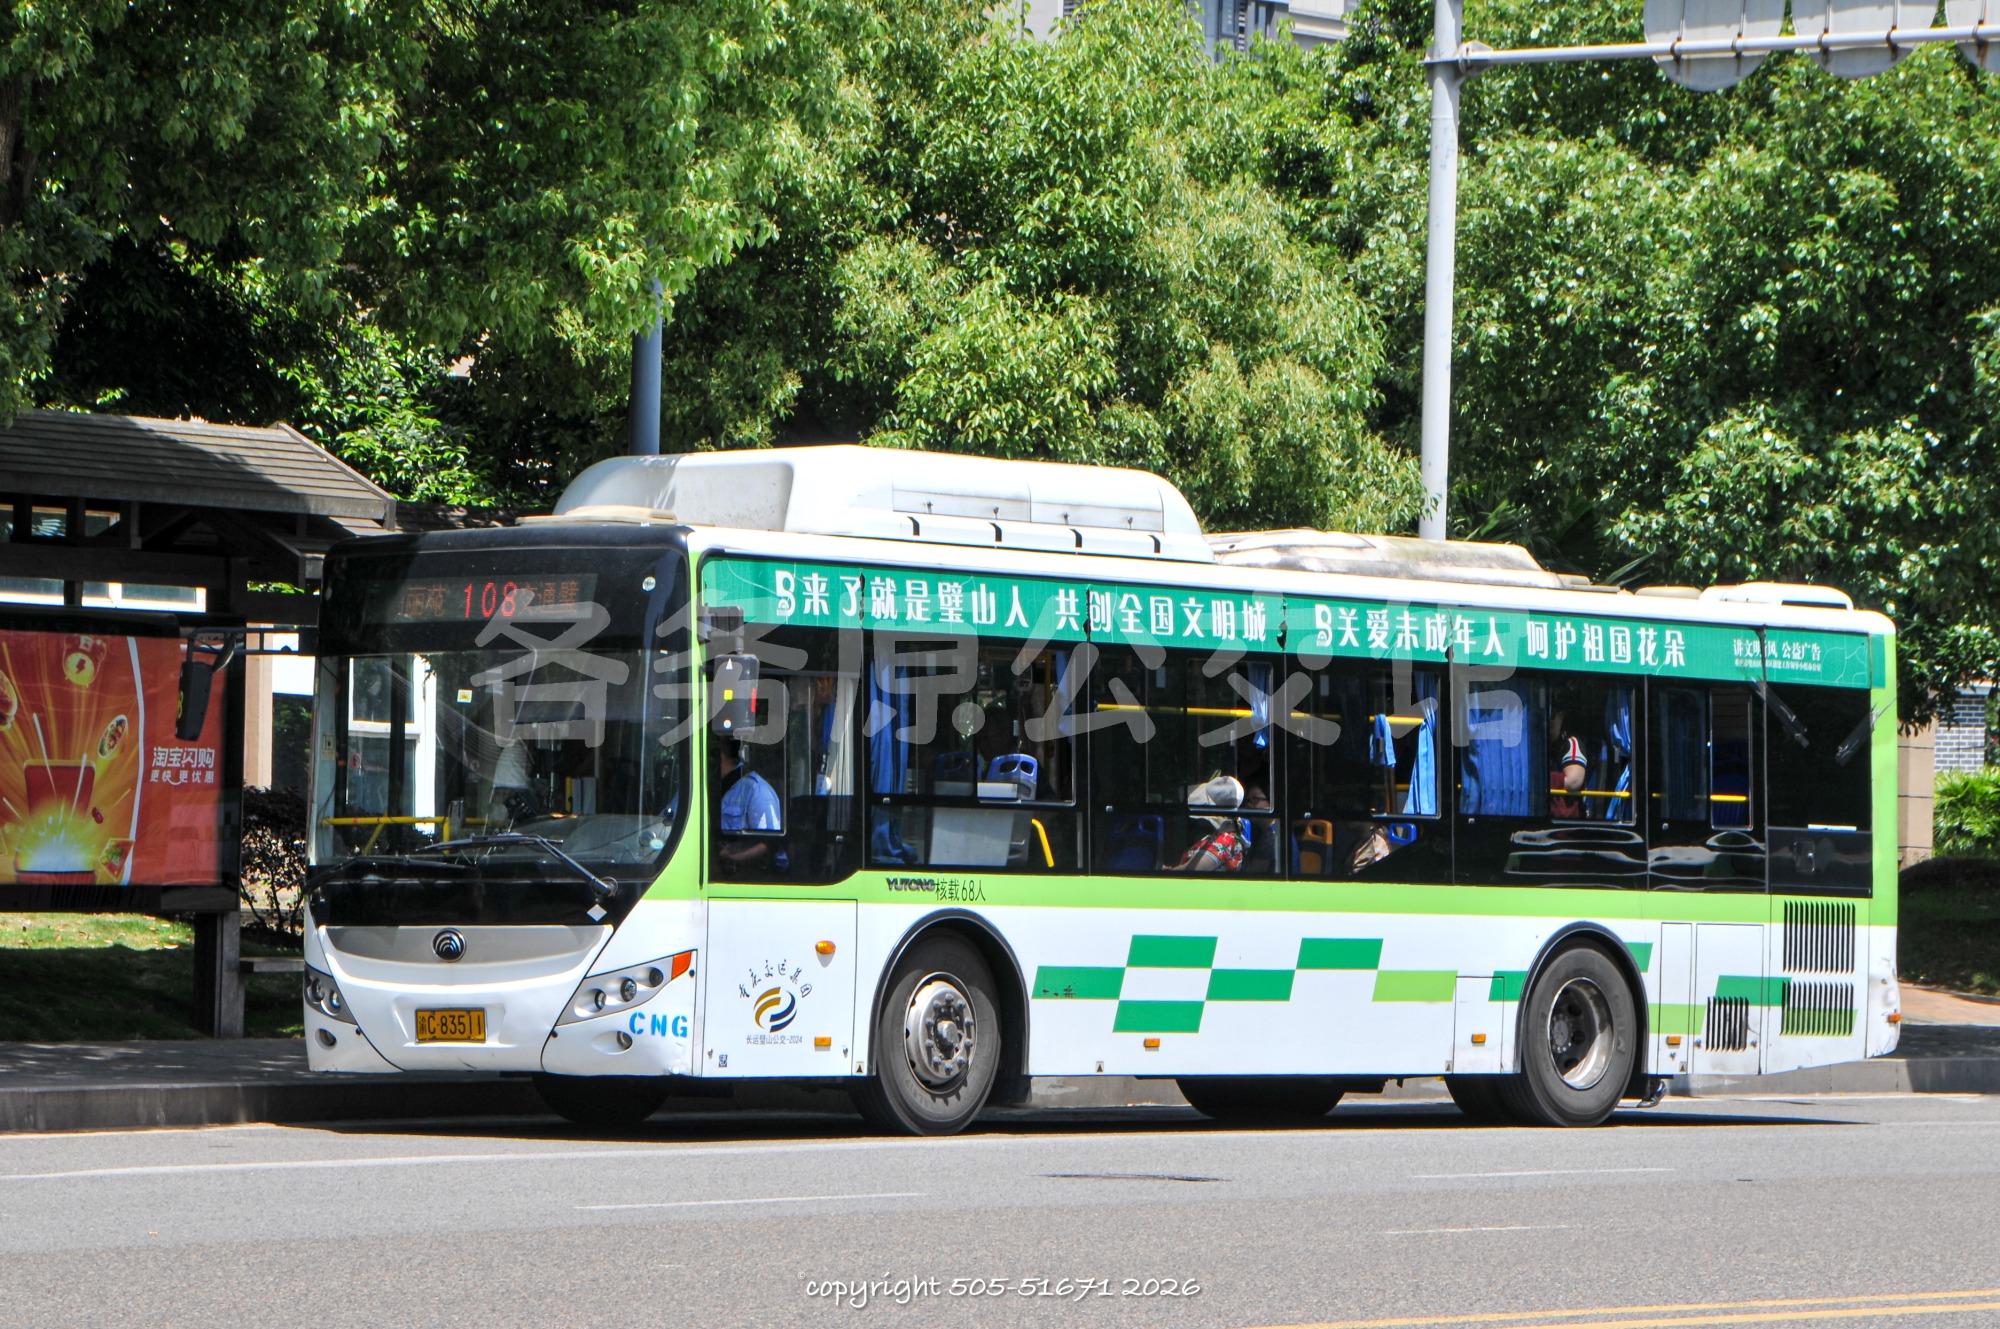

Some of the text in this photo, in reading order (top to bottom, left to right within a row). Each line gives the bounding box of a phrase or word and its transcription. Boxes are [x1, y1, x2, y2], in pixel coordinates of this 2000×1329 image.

[463, 581, 518, 618] 108
[802, 571, 1267, 642] 来了就是璧山人 共创全国文明城
[1338, 606, 1686, 668] 关爱未成年人 呵护祖国花朵
[1782, 640, 1821, 662] 公益广告
[152, 747, 215, 768] 淘宝闪购
[885, 877, 936, 892] YUTONG
[935, 878, 986, 902] 核载68人
[629, 1011, 688, 1038] CNG
